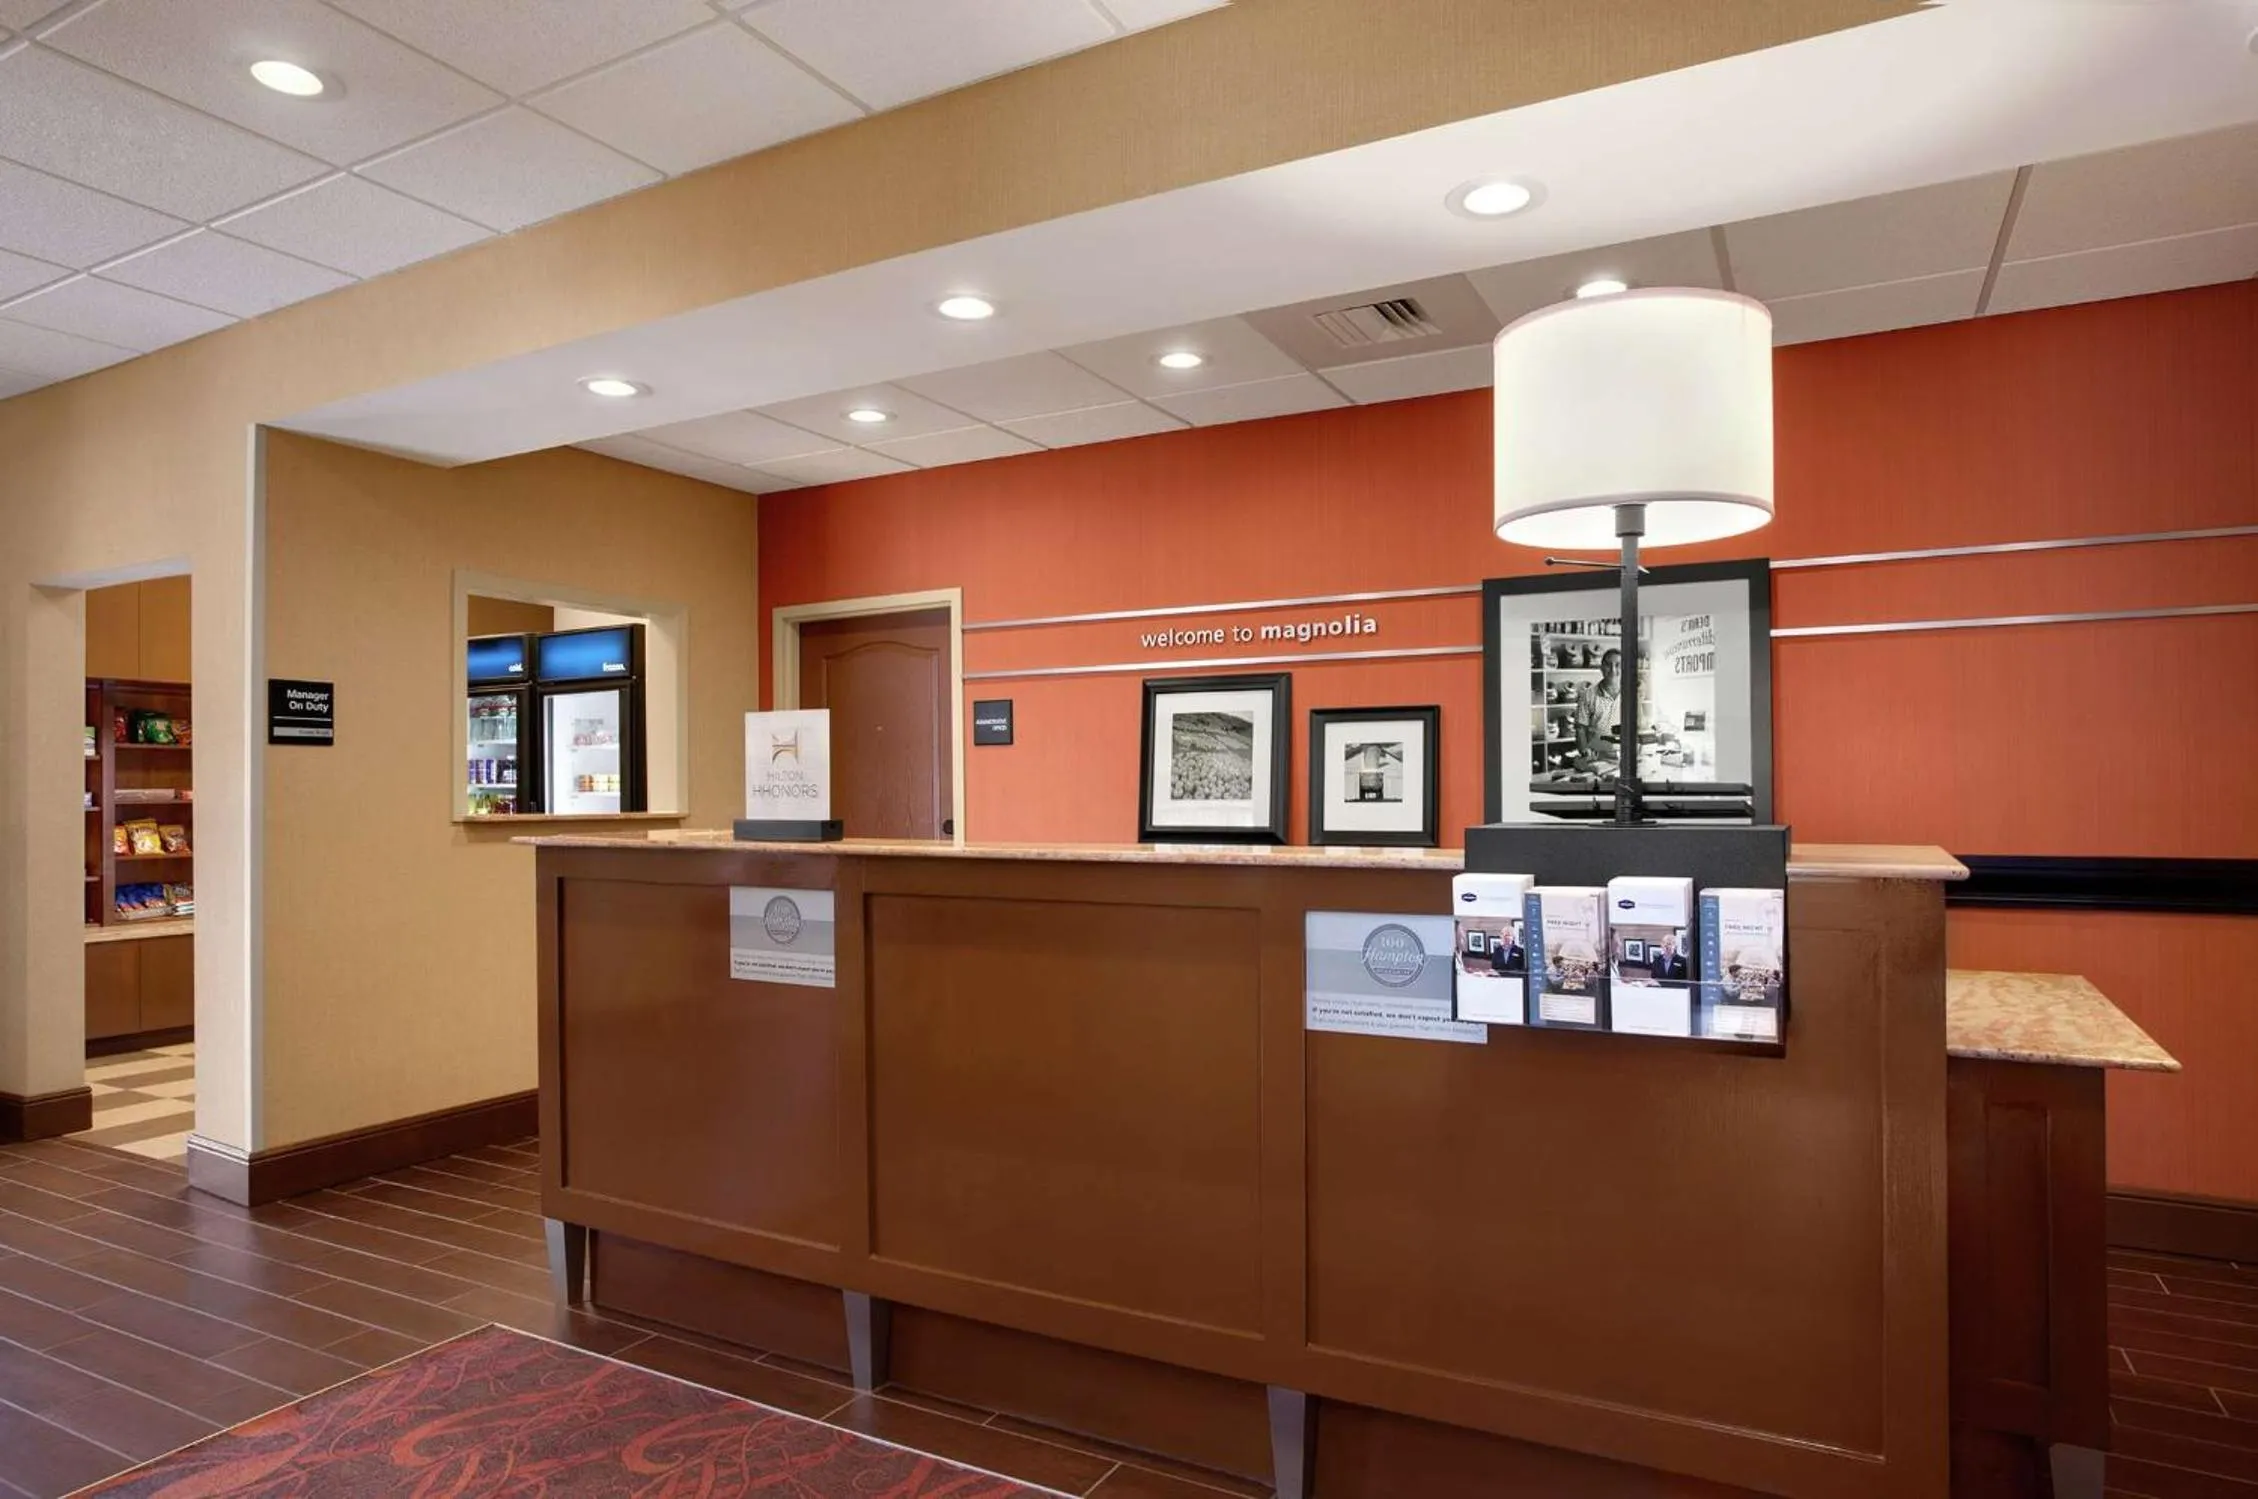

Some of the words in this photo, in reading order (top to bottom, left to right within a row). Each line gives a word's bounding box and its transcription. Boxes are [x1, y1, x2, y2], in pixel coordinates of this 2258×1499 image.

[1141, 627, 1225, 649] welcome
[1232, 625, 1253, 642] to
[1260, 613, 1378, 647] magnolia
[287, 689, 329, 701] Manager
[289, 701, 303, 710] On
[306, 702, 329, 713] Duty
[767, 770, 803, 781] HILTON
[752, 783, 818, 798] HHONORS
[1361, 945, 1424, 966] Hampton
